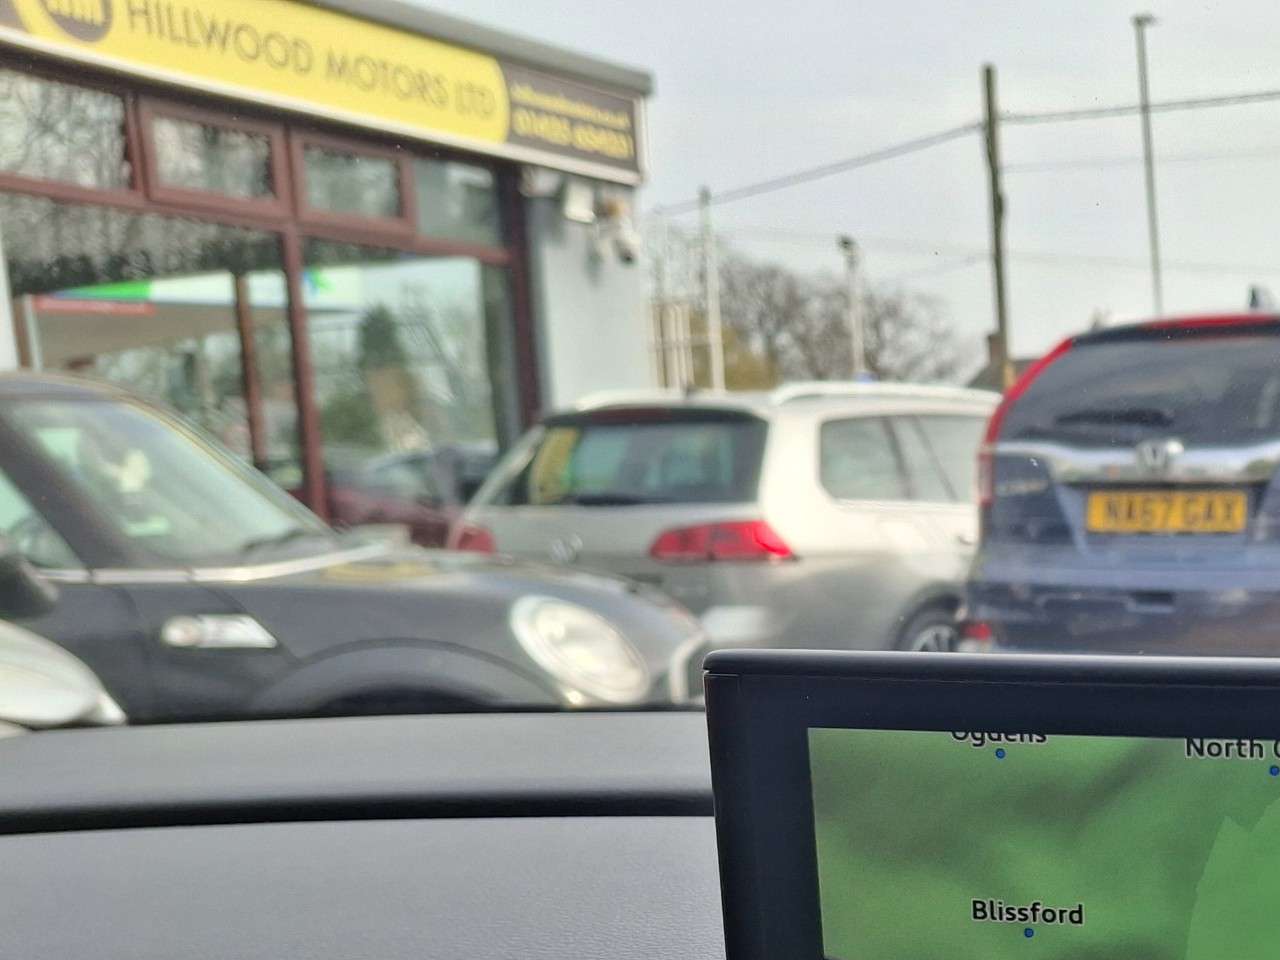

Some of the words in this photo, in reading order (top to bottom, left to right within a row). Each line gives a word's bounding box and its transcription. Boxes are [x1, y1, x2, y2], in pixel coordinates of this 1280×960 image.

[125, 1, 314, 74] HILLWOOD
[325, 44, 449, 110] MOTORS
[1185, 738, 1264, 759] North
[972, 900, 1084, 925] Blissford
